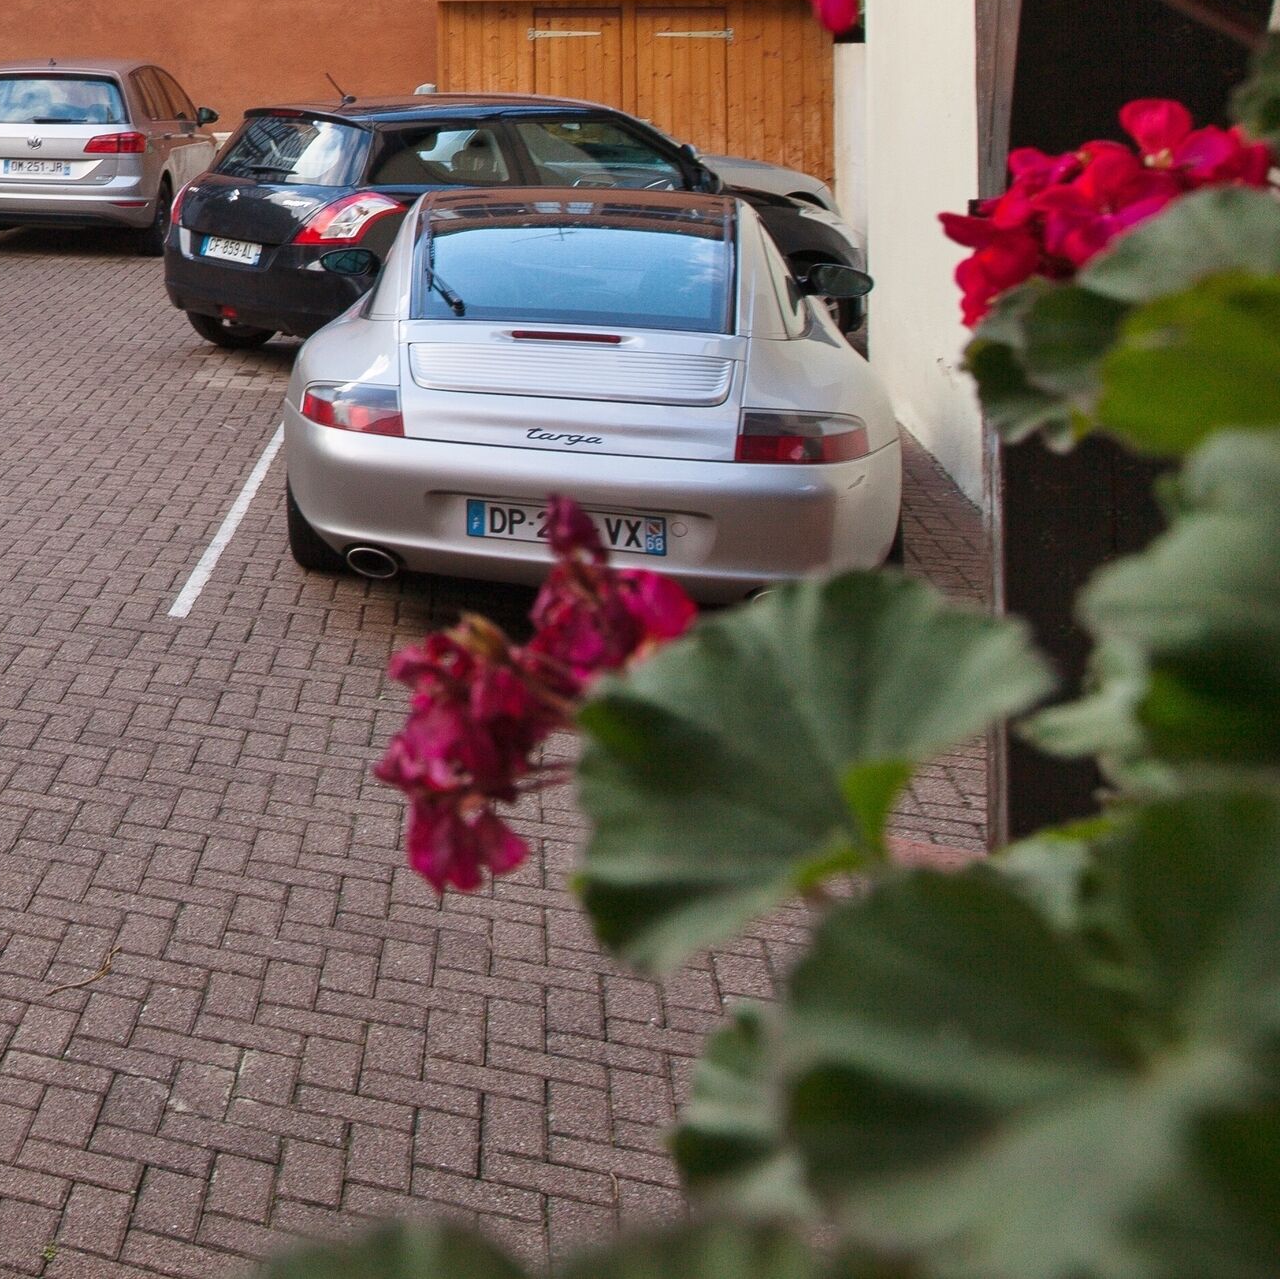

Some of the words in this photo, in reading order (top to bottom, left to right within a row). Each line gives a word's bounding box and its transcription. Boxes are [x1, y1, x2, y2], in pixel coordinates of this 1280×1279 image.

[526, 427, 603, 446] targa
[490, 507, 642, 548] DP-2-VX
[646, 536, 665, 551] 68
